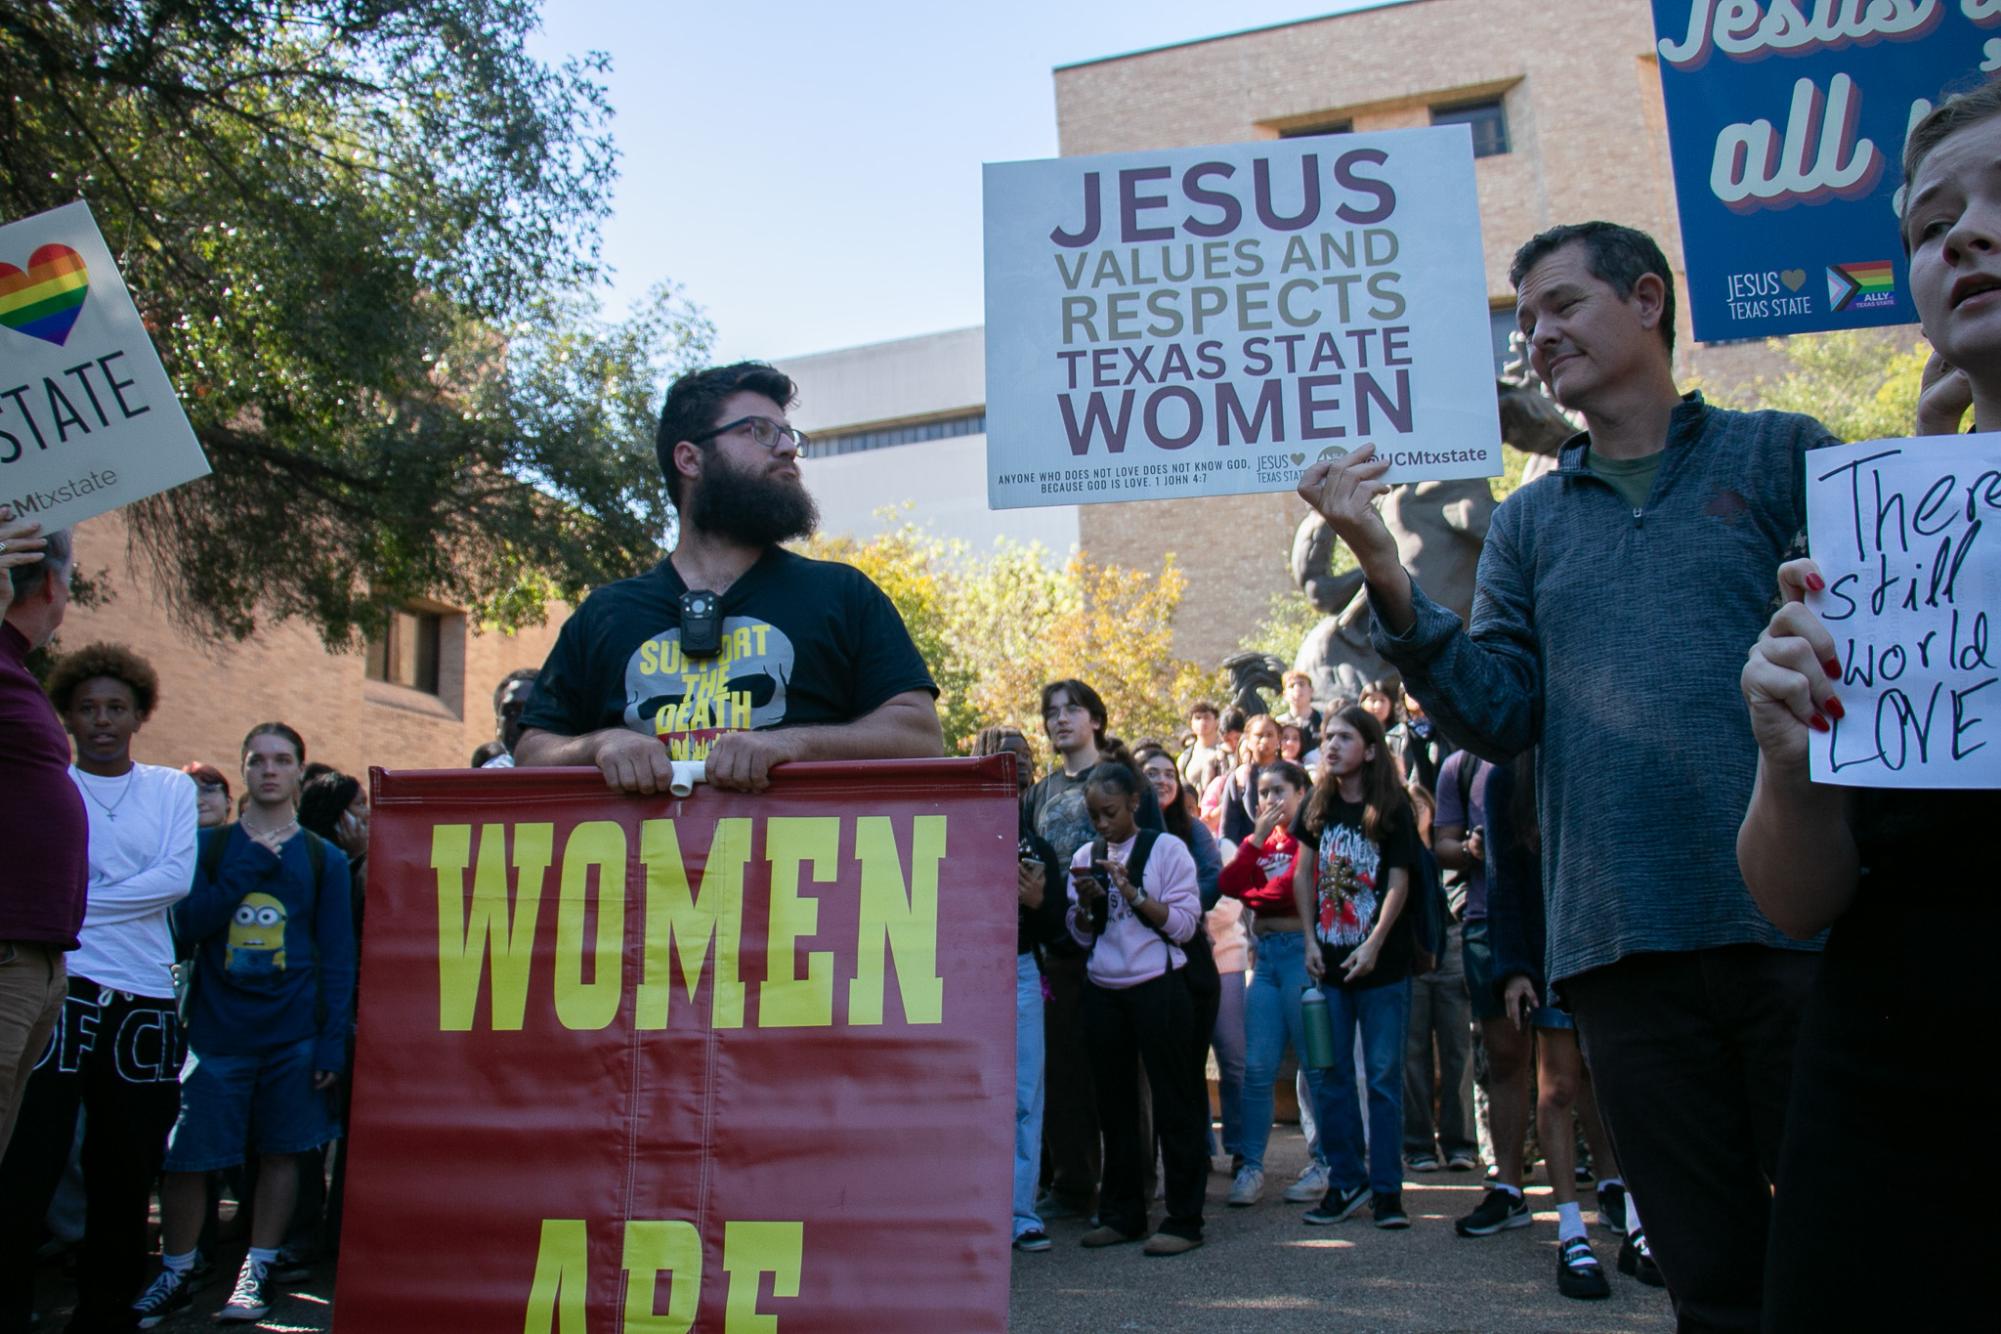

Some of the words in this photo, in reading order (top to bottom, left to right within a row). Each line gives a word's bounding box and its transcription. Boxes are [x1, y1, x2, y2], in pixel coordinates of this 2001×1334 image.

[1710, 72, 1878, 206] all
[1050, 148, 1397, 248] JESUS
[1054, 238, 1265, 290] VALUES
[1280, 228, 1399, 274] AND
[1062, 272, 1407, 344] RESPECTS
[1727, 271, 1780, 302] JESUS
[1729, 301, 1769, 320] TEXAS
[1772, 296, 1813, 317] STATE
[1864, 292, 1889, 302] ALLY
[1057, 340, 1227, 389] TEXAS
[1242, 325, 1413, 376] STATE
[1057, 368, 1414, 456] WOMEN
[998, 472, 1036, 485] ANYONE
[1039, 471, 1061, 482] WHO
[1065, 469, 1090, 481] DOES
[1093, 467, 1112, 479] NOT
[1116, 465, 1139, 478] LOVE
[1143, 464, 1168, 476] DOES
[1172, 462, 1190, 474] NOT
[1195, 460, 1223, 472] KNOW
[1041, 481, 1084, 494] BECAUSE
[1087, 480, 1107, 491] GOD
[1111, 478, 1121, 489] IS
[1124, 477, 1152, 489] LOVE.
[1164, 474, 1189, 487] JOHN
[1193, 473, 1207, 484] 4:7
[1256, 454, 1289, 472] JESUS
[1257, 471, 1282, 483] TEXAS
[1283, 469, 1305, 482] STAT
[639, 624, 771, 676] SUORT
[682, 665, 731, 705] THE
[655, 690, 752, 736] DEATH
[1830, 678, 1999, 773] LOVE
[430, 815, 948, 1031] WOMEN
